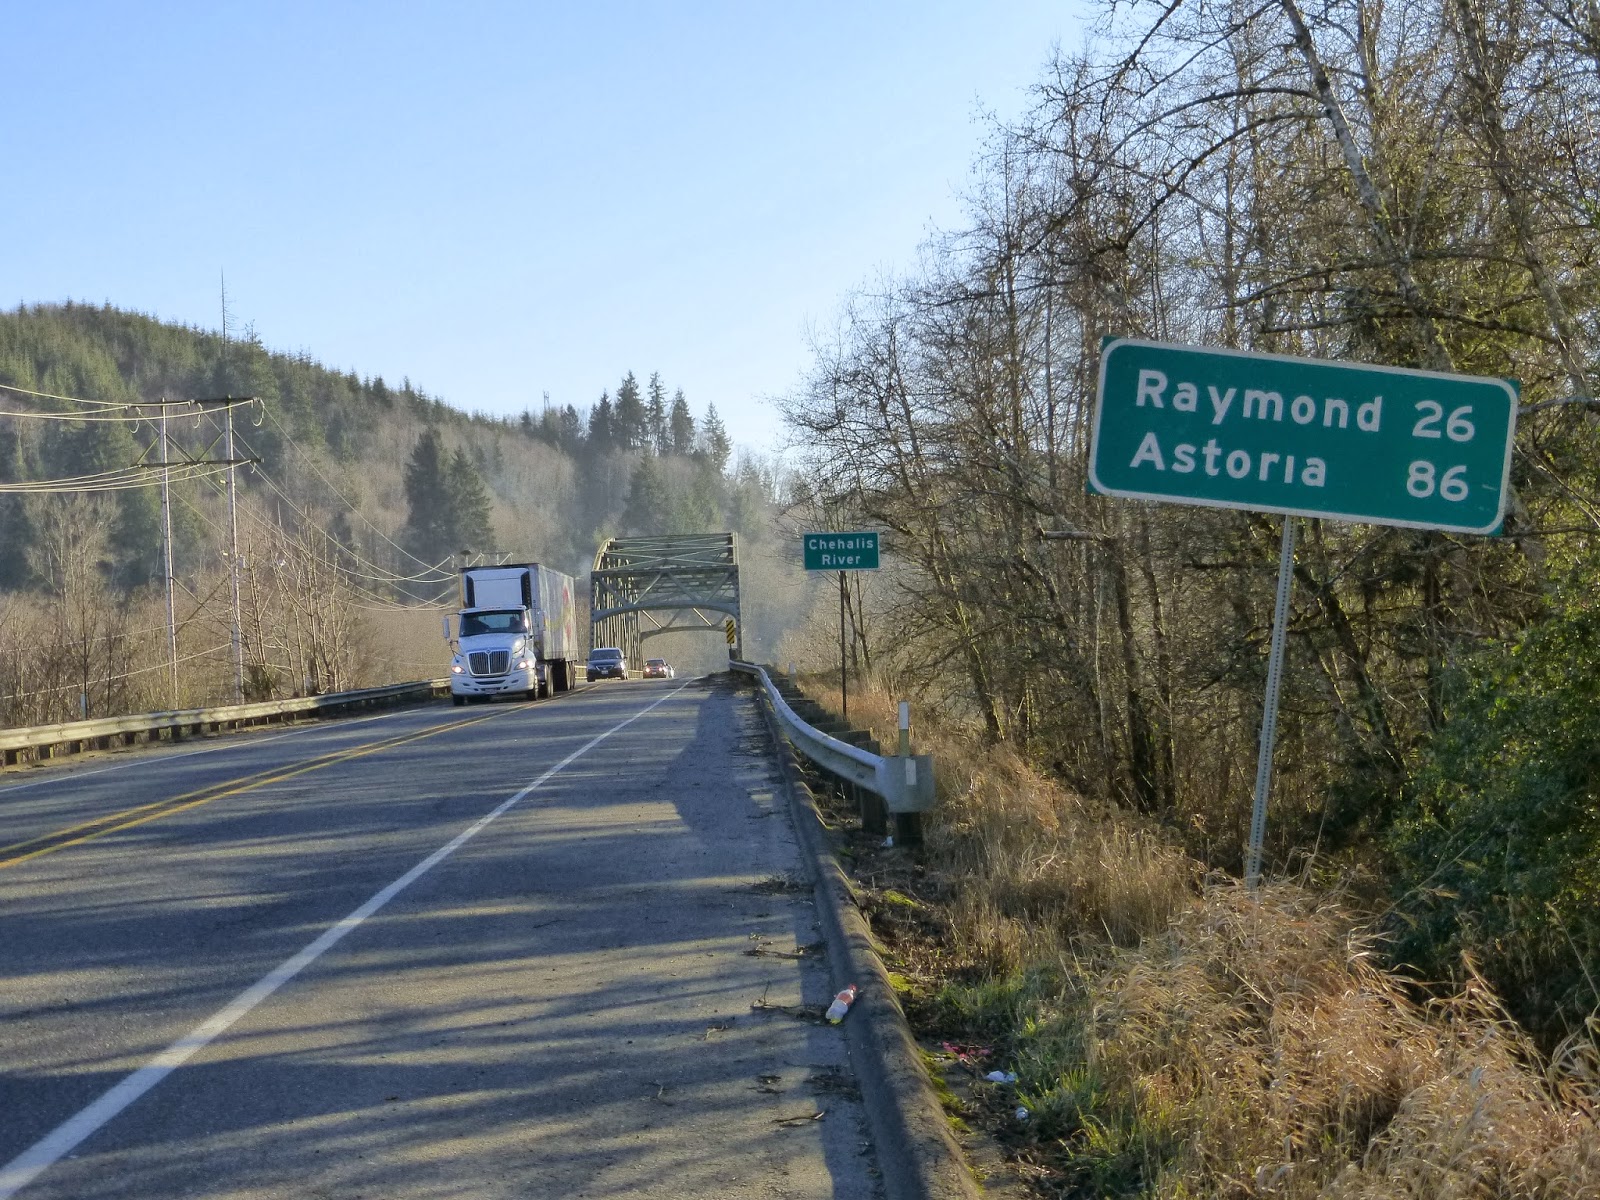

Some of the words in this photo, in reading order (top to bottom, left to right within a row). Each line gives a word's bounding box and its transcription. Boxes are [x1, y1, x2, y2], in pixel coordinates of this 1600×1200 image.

[1135, 369, 1383, 432] Raymond
[1411, 400, 1475, 442] 26
[1129, 431, 1327, 488] Astoria
[1406, 460, 1470, 501] 86
[808, 538, 874, 550] Chehalis
[822, 554, 861, 565] River
